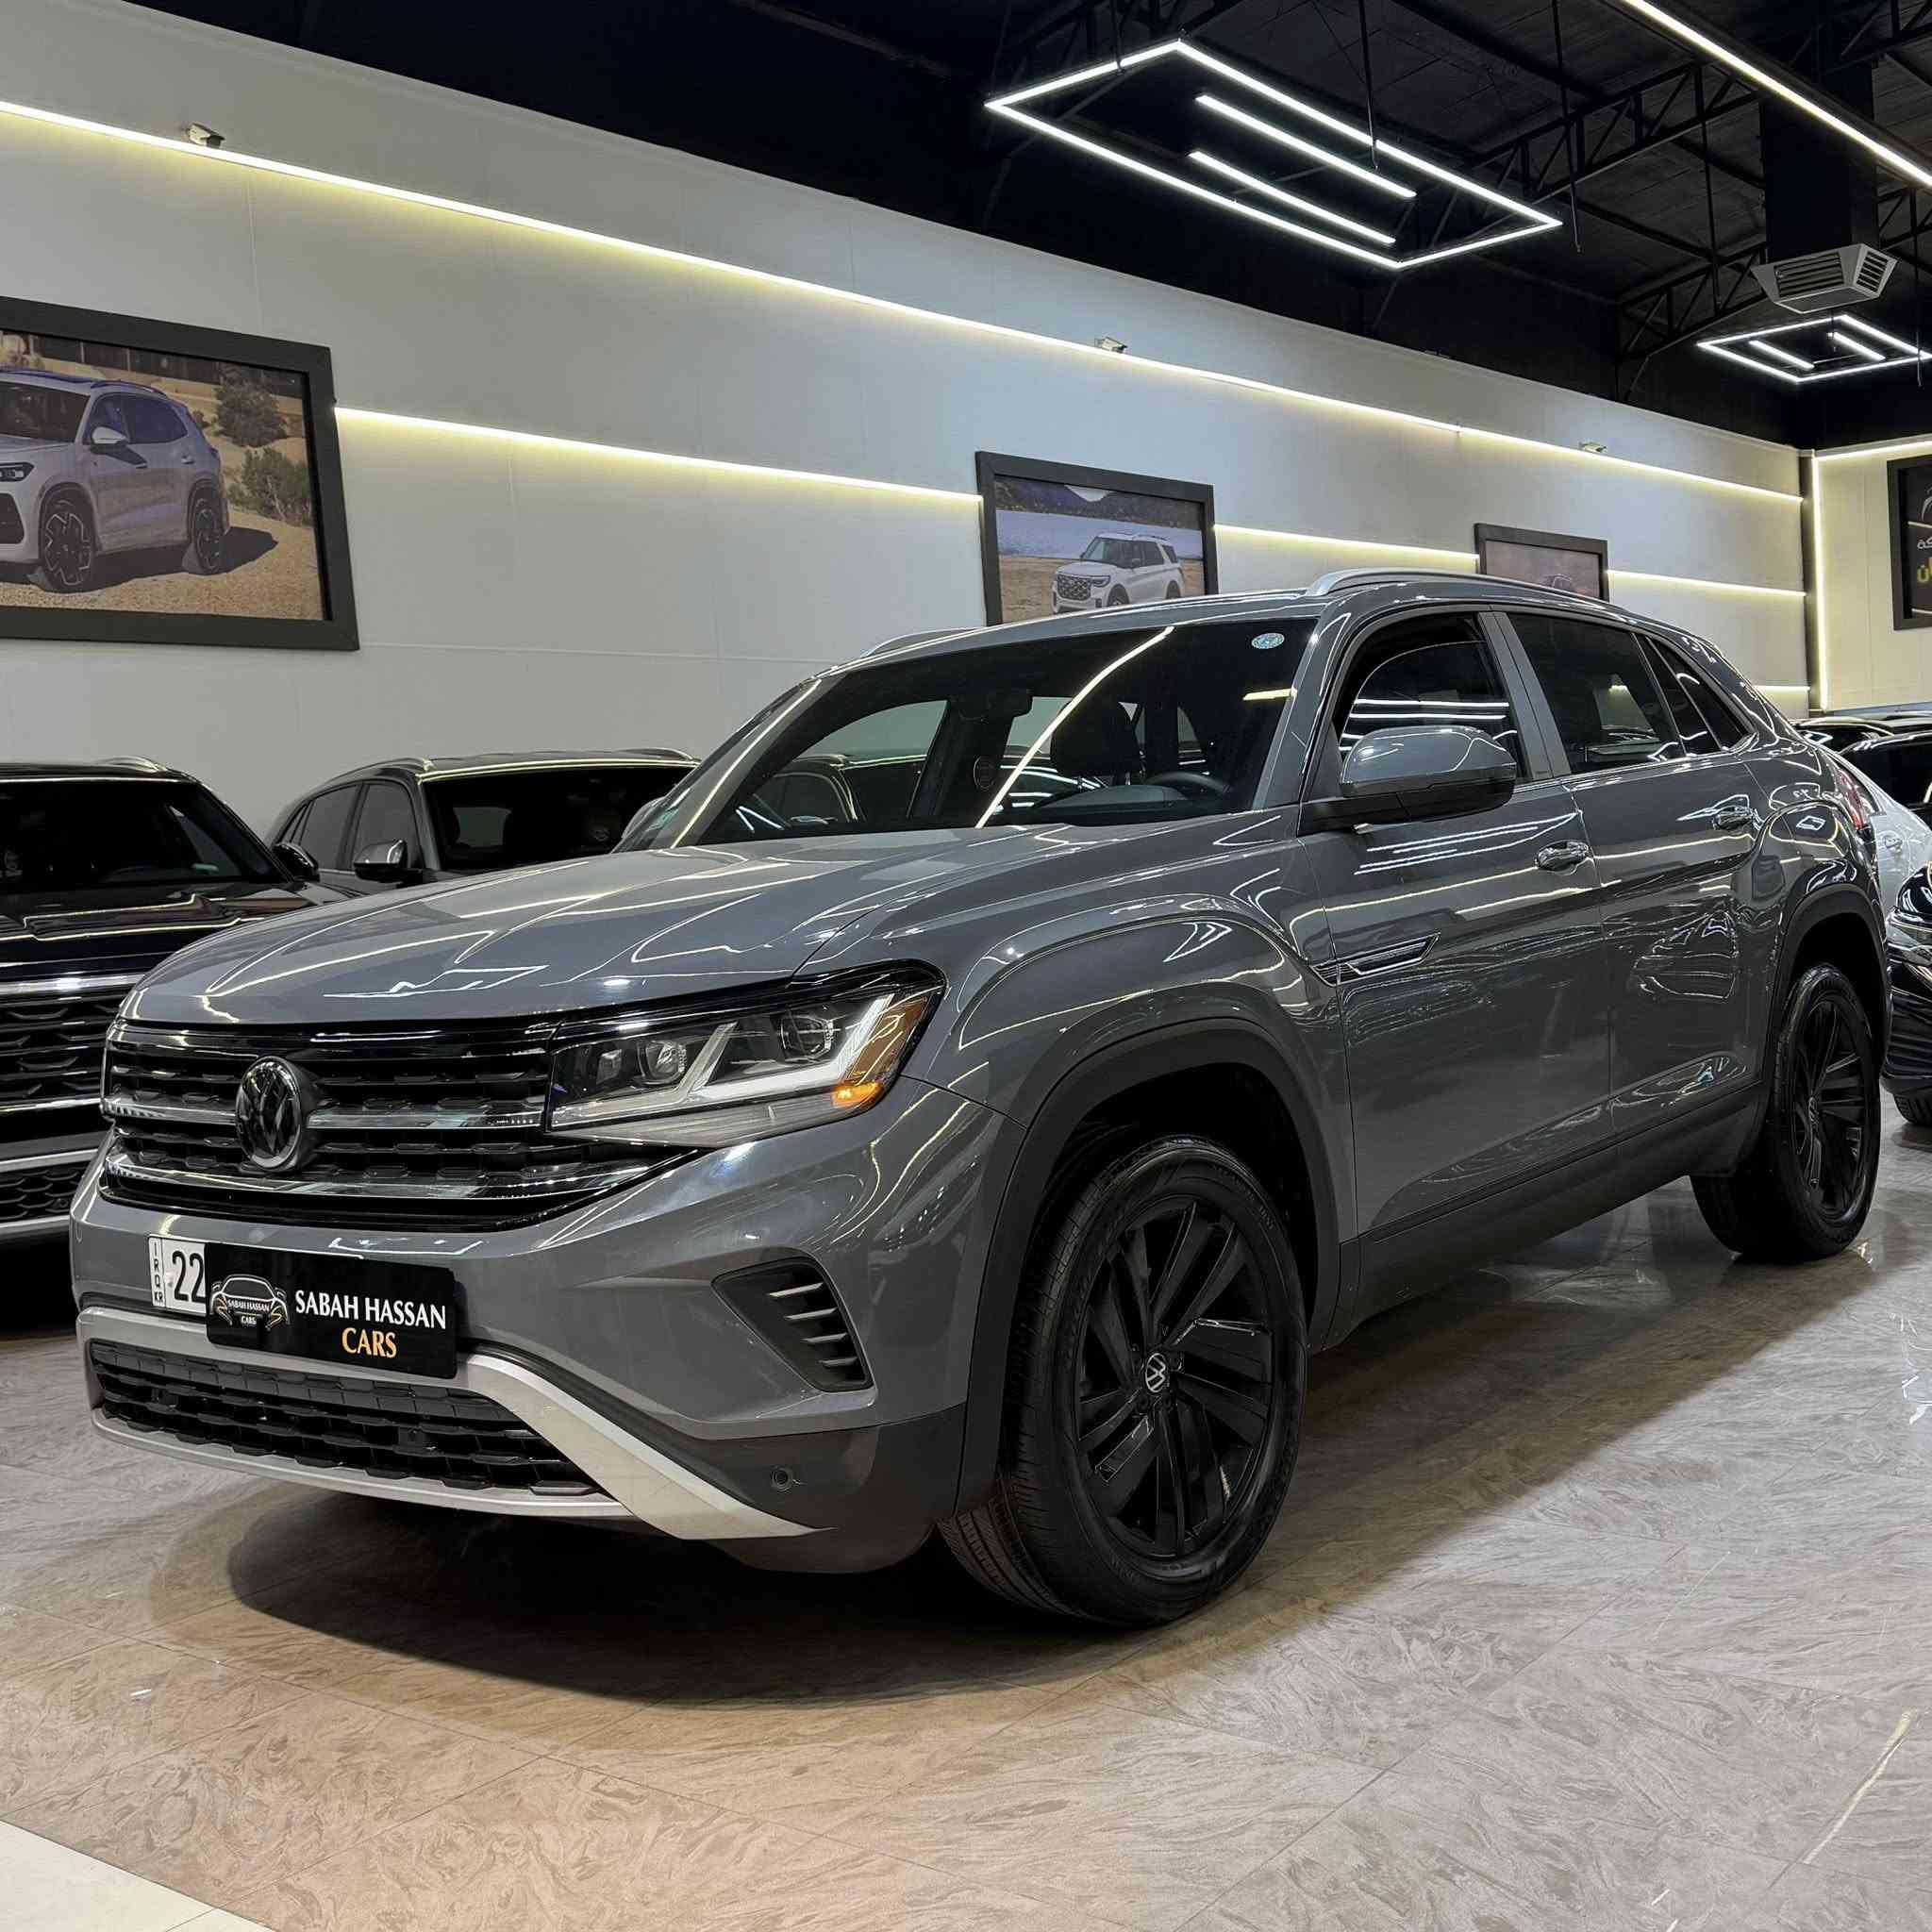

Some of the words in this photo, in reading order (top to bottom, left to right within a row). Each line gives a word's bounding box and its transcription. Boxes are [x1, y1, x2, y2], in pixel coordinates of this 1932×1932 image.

[294, 1290, 358, 1320] SABAH
[365, 1297, 446, 1329] HASSAN
[341, 1327, 397, 1358] CARS
